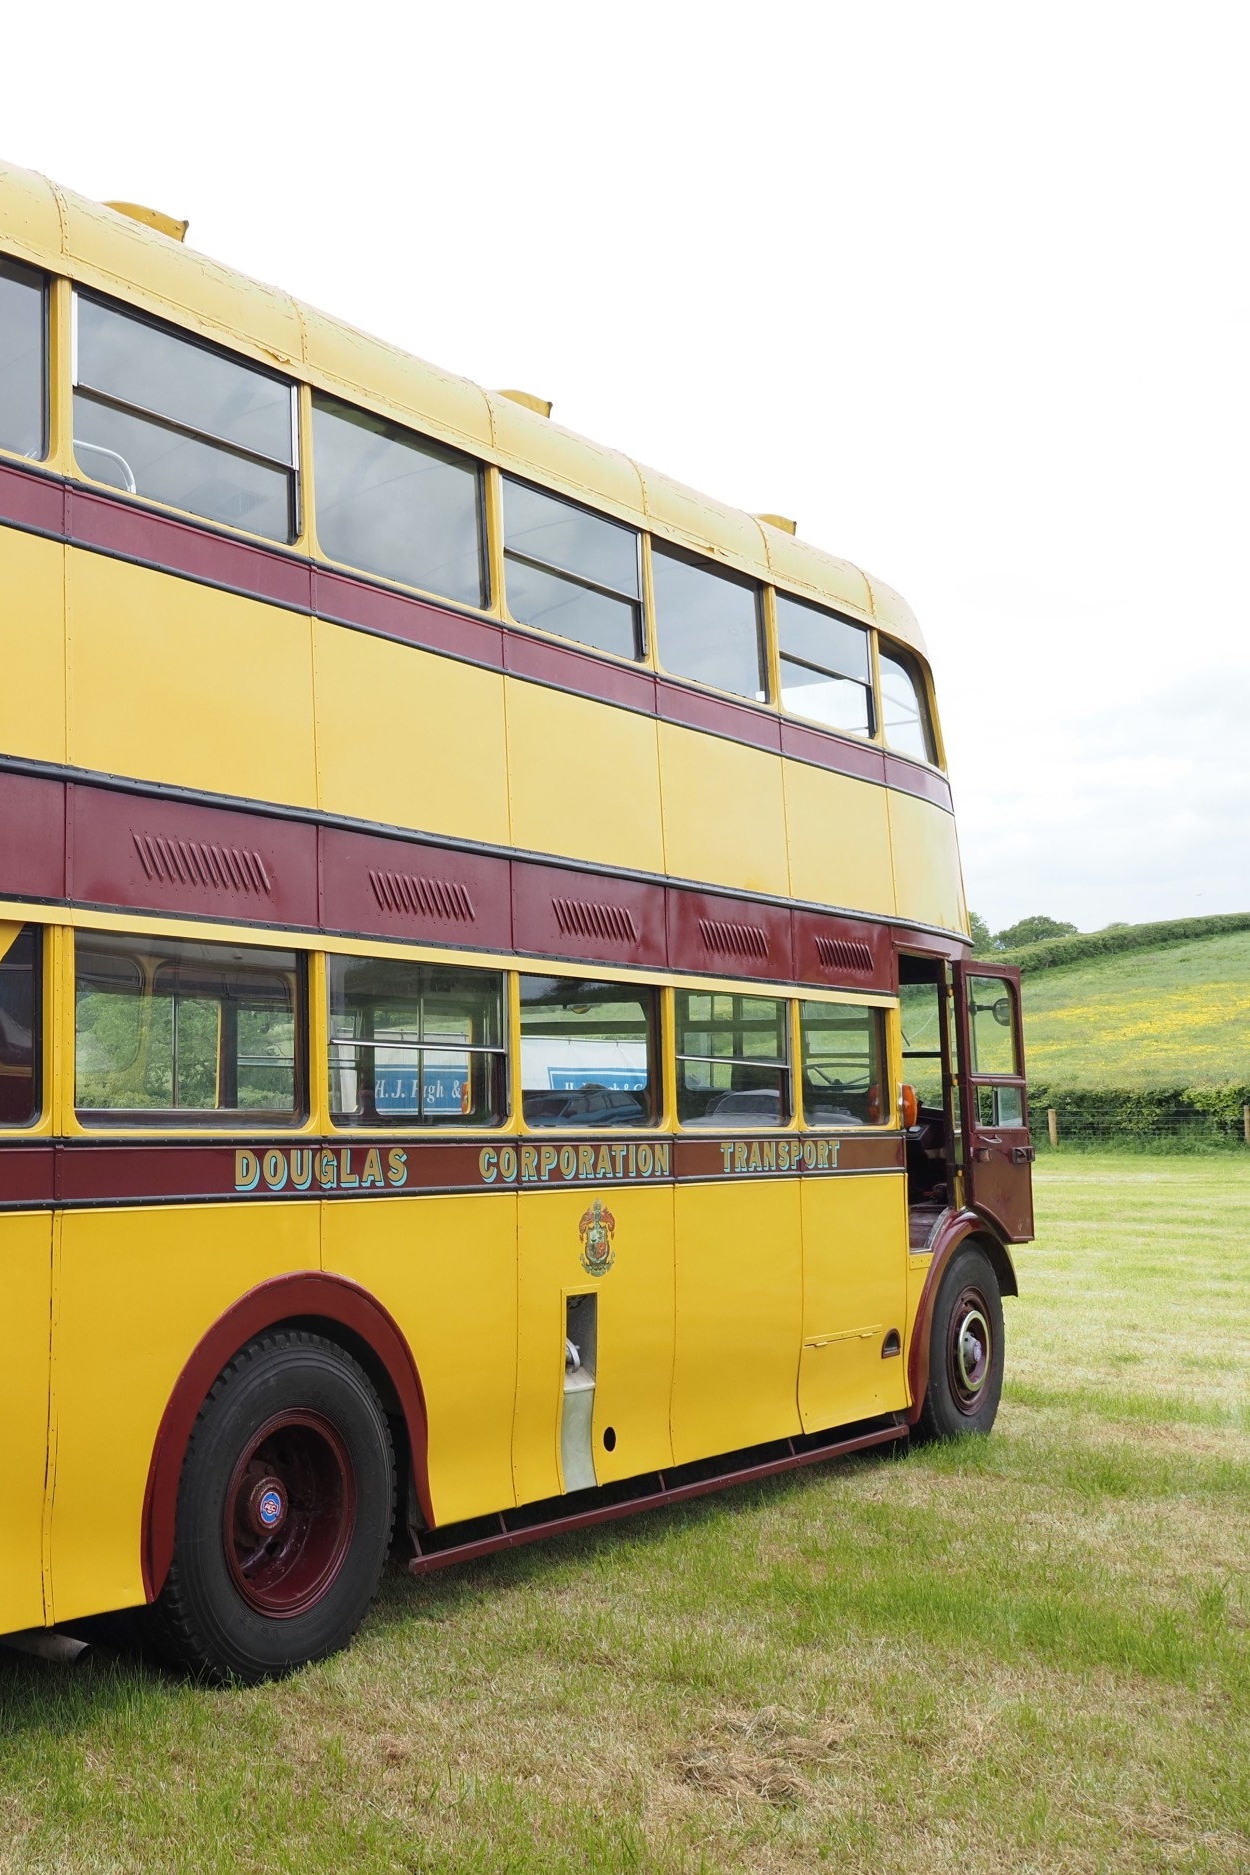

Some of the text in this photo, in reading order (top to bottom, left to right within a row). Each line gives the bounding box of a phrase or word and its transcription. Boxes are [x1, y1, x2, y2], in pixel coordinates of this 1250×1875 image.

[234, 1140, 841, 1192] DOUGLAS CORPORATION TRANSPORT
